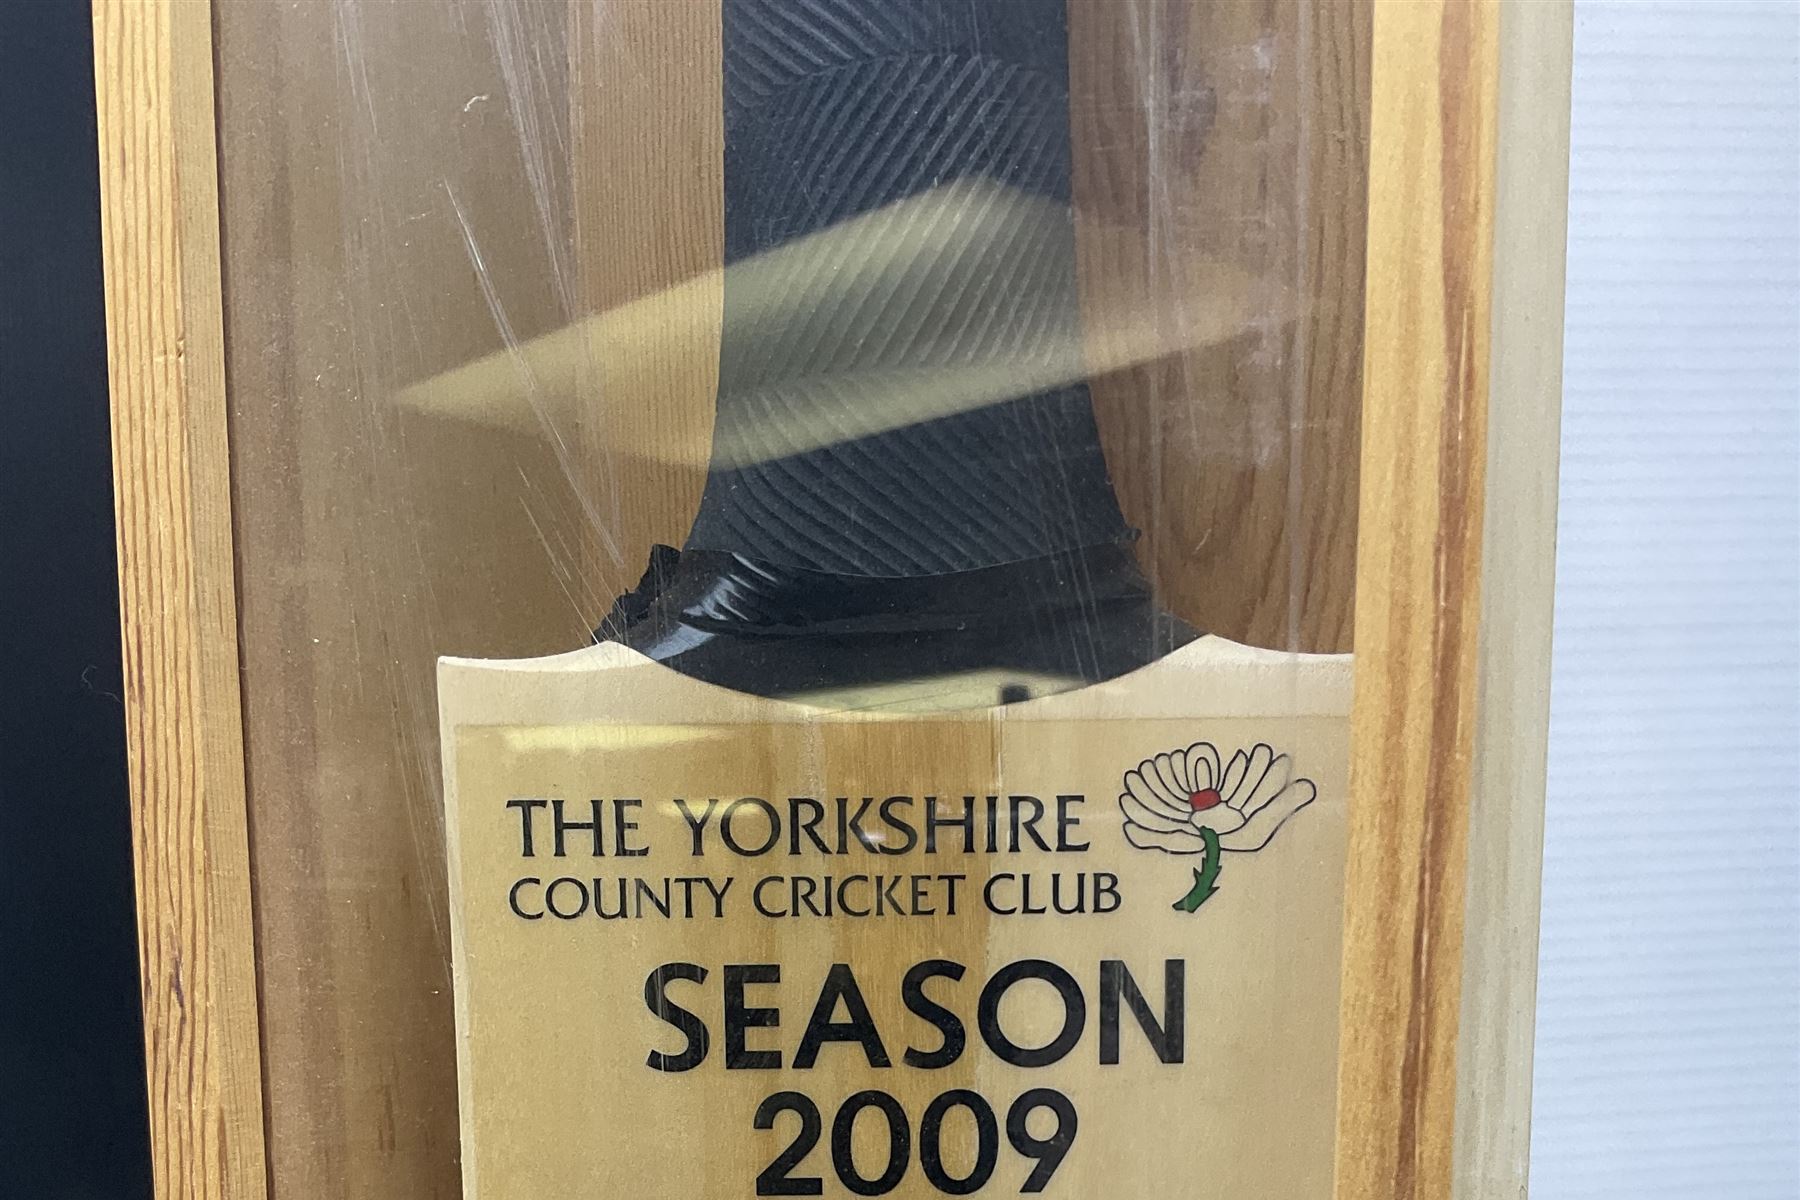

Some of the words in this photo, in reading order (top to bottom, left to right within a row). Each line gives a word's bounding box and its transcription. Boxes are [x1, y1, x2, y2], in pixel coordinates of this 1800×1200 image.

[507, 799, 650, 857] THE
[674, 795, 1090, 856] YORKSHIRE
[508, 876, 734, 920] COUNTY
[753, 874, 968, 917] CRICKET
[983, 873, 1122, 915] CLUB
[644, 959, 1186, 1073] SEASON
[753, 1088, 1079, 1197] 2009
